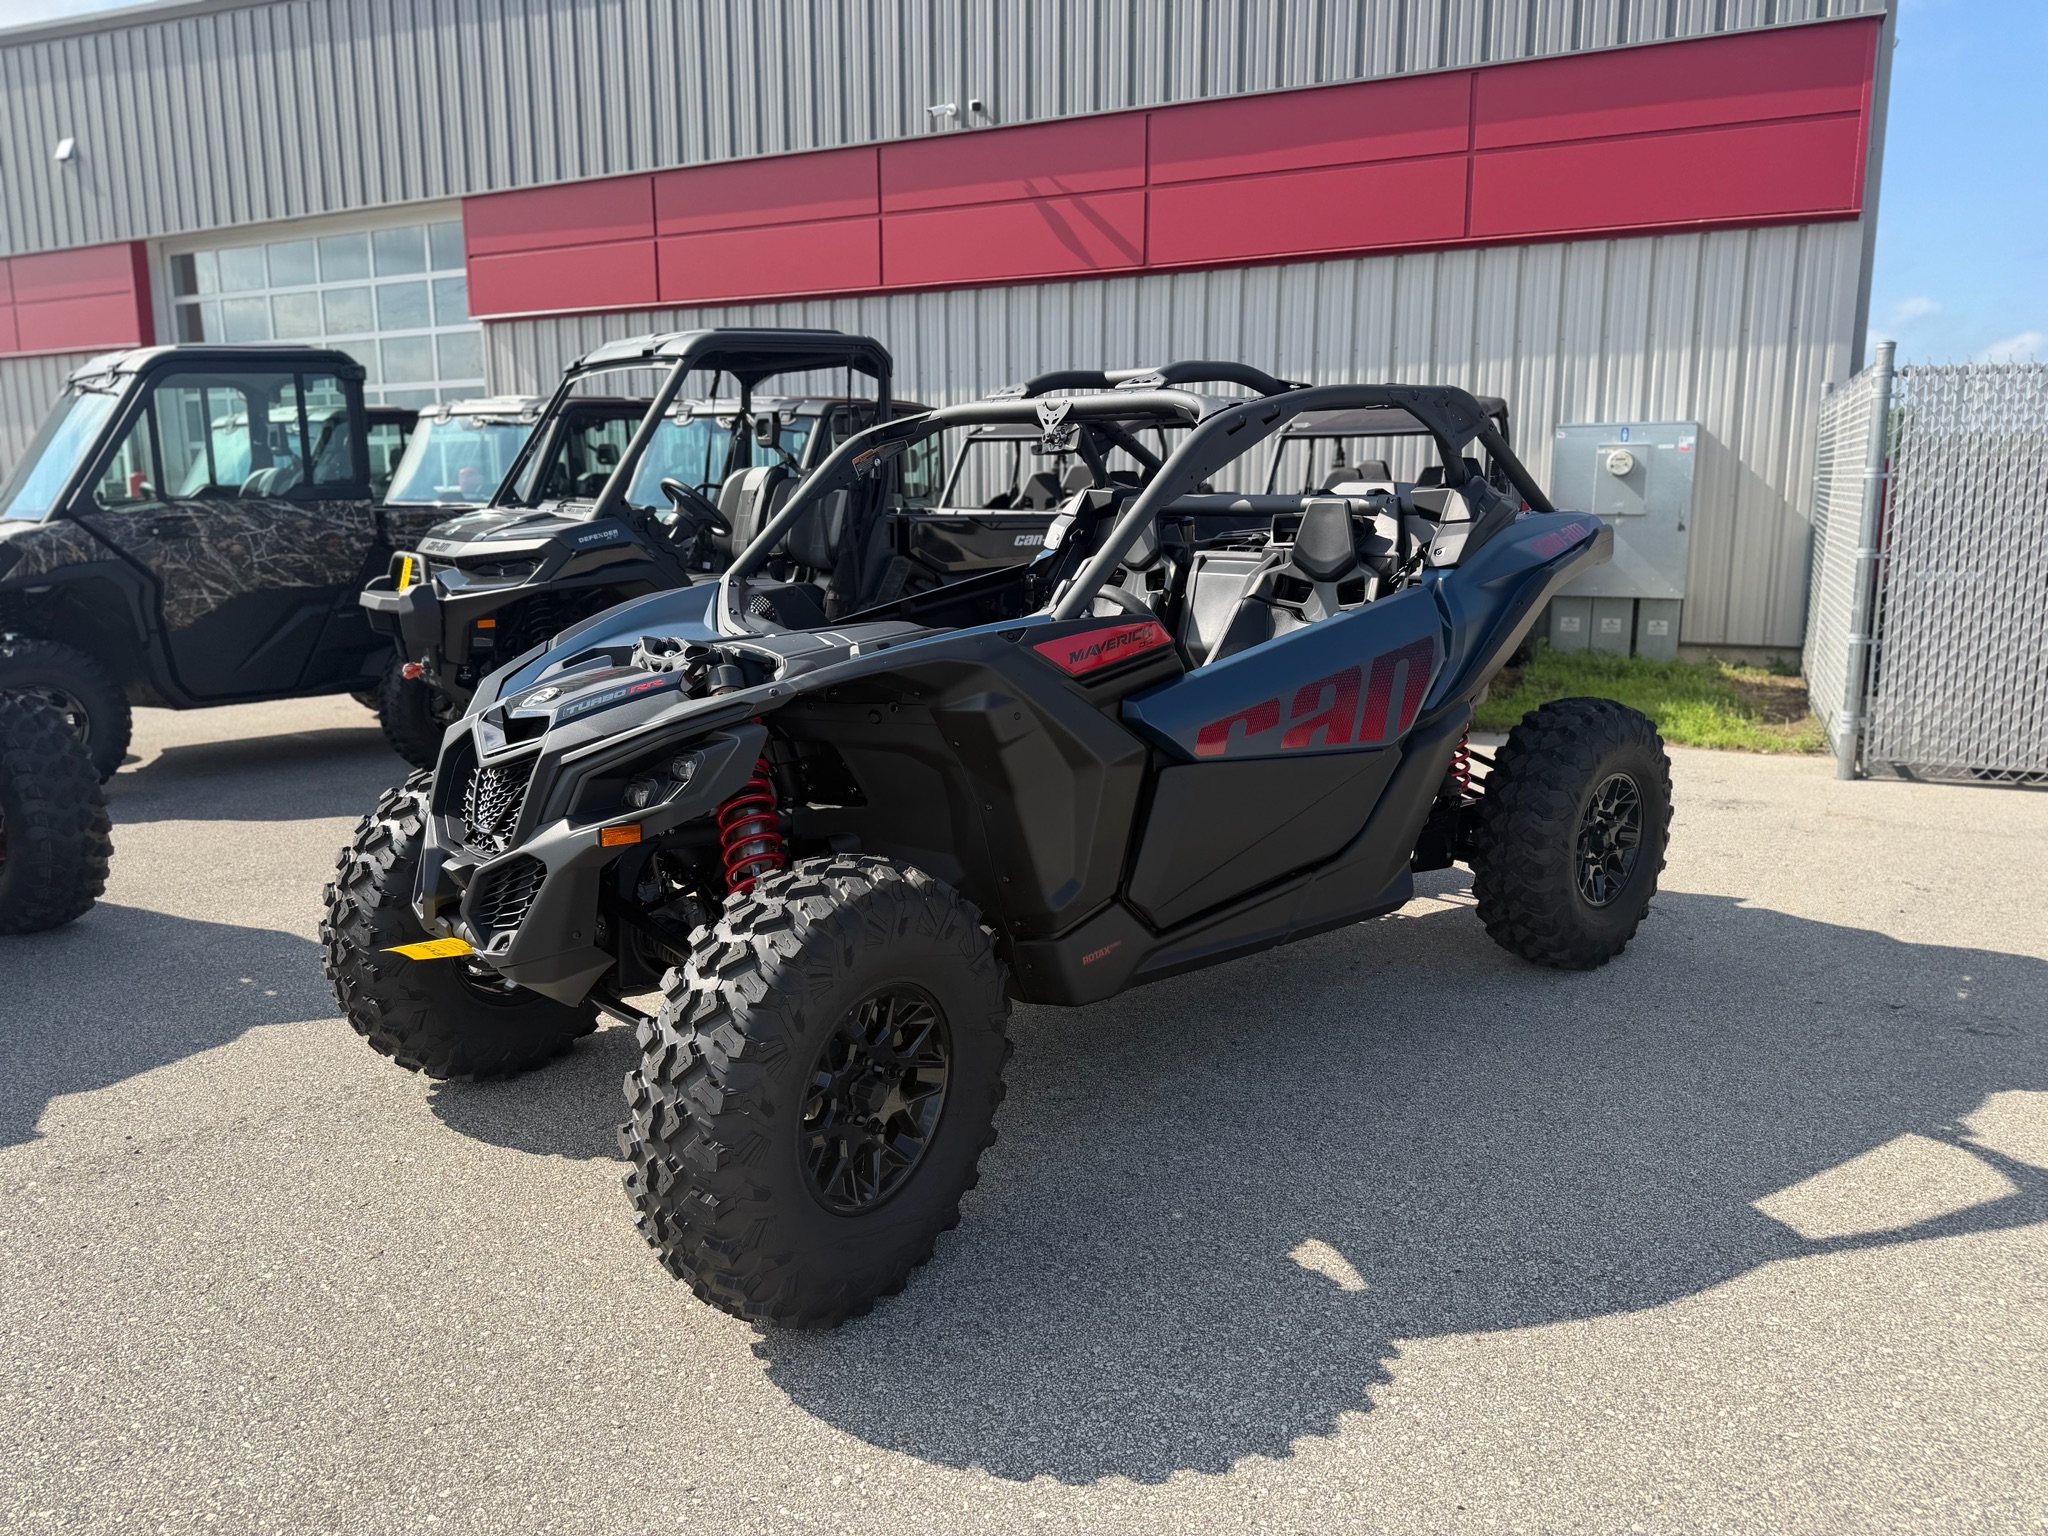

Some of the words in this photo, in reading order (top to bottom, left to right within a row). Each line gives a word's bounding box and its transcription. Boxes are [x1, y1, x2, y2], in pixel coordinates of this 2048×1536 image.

[578, 529, 618, 543] DEFENDER
[1069, 625, 1153, 664] MAVERICK
[566, 689, 627, 714] TURBO
[630, 679, 664, 694] RR
[1082, 946, 1111, 966] ROTAX
